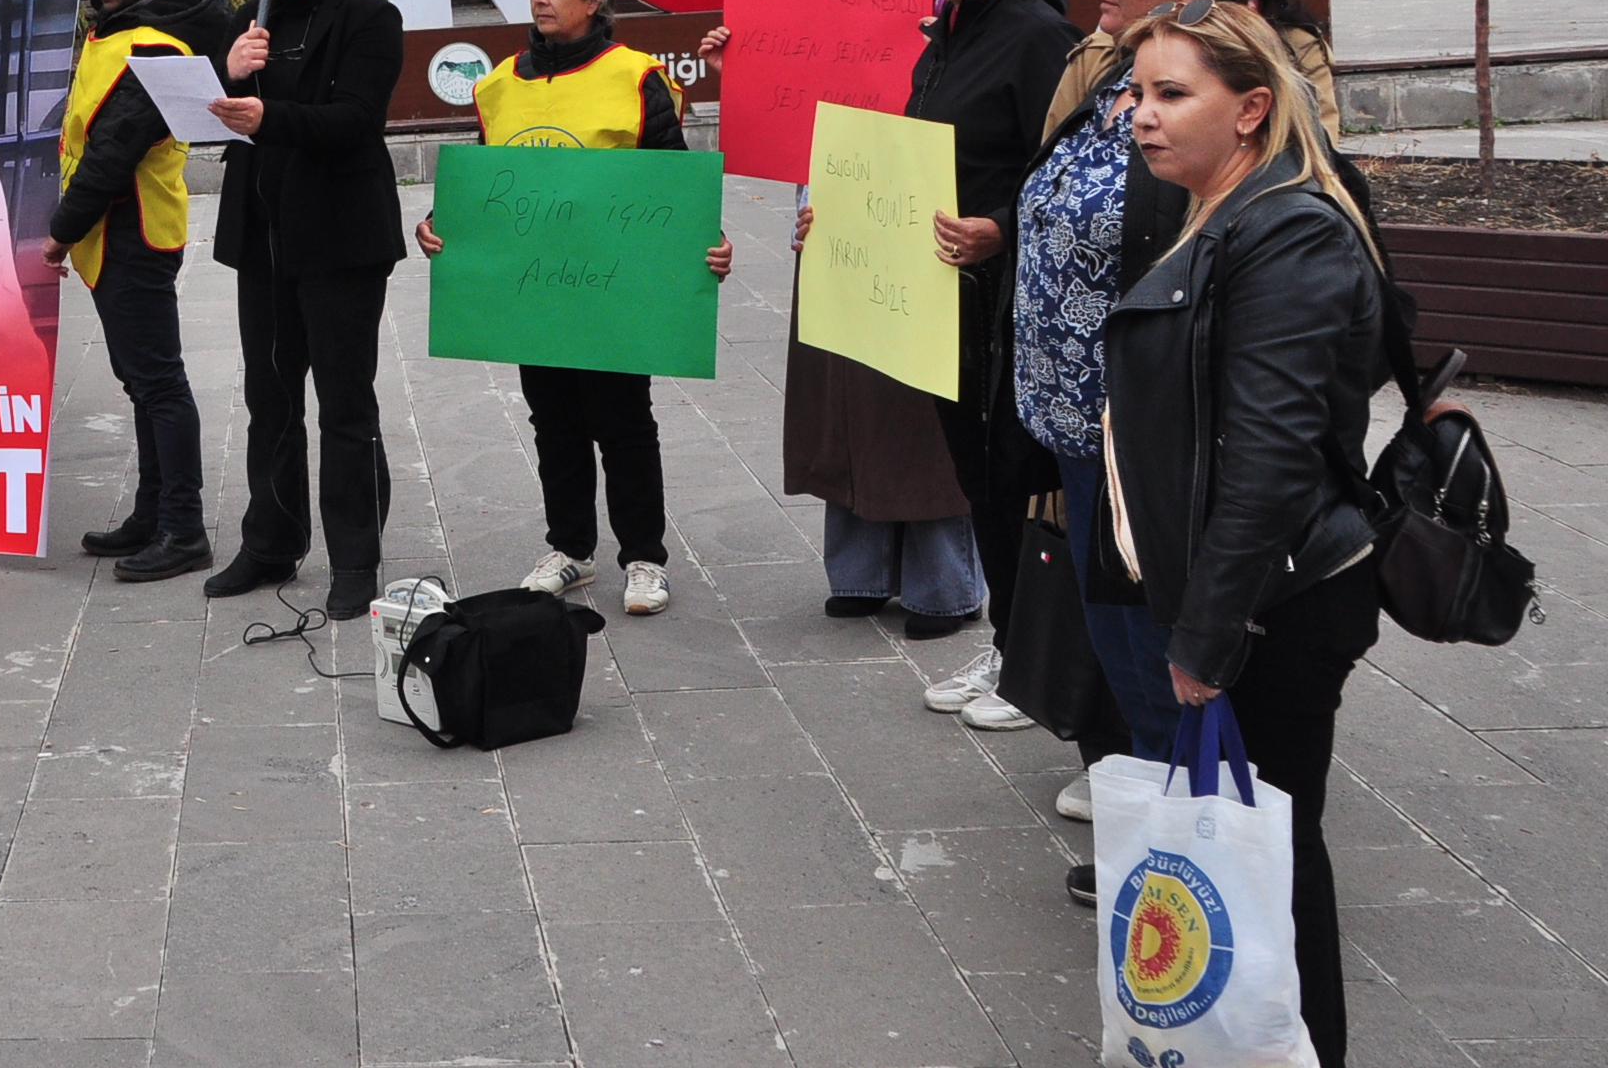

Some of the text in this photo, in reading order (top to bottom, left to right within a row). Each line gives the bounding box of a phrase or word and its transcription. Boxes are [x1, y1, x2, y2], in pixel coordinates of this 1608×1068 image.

[765, 85, 806, 112] SES
[825, 153, 871, 181] BUGÜN
[483, 169, 673, 236] Rojin için
[828, 236, 869, 269] YARIN
[518, 257, 620, 295] Adalet
[1166, 892, 1200, 932] SEN
